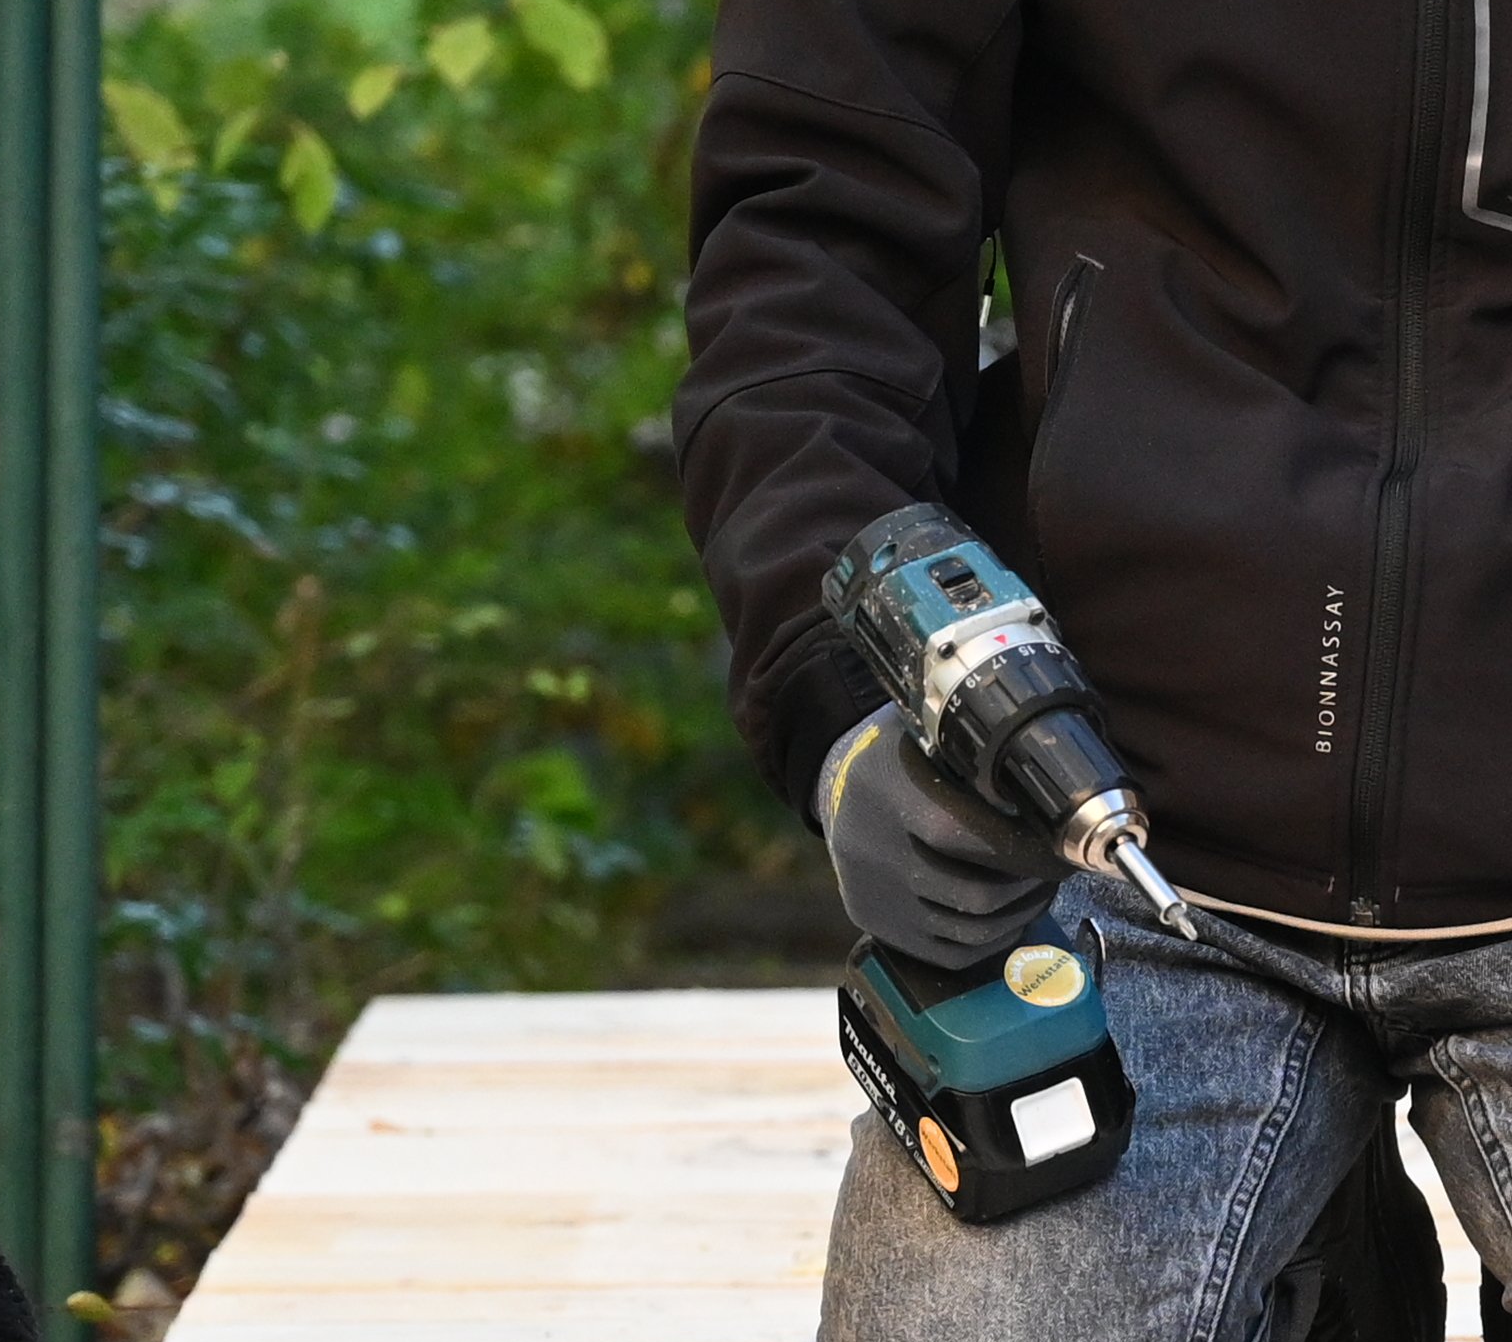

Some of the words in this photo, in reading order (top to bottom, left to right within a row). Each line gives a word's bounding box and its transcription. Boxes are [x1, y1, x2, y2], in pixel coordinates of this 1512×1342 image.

[1018, 645, 1036, 657] 15
[991, 655, 1007, 670] 17
[1315, 584, 1345, 753] BIONNASSAY
[965, 672, 982, 689] 19
[947, 693, 962, 713] 21
[1017, 954, 1071, 997] Werkstatt
